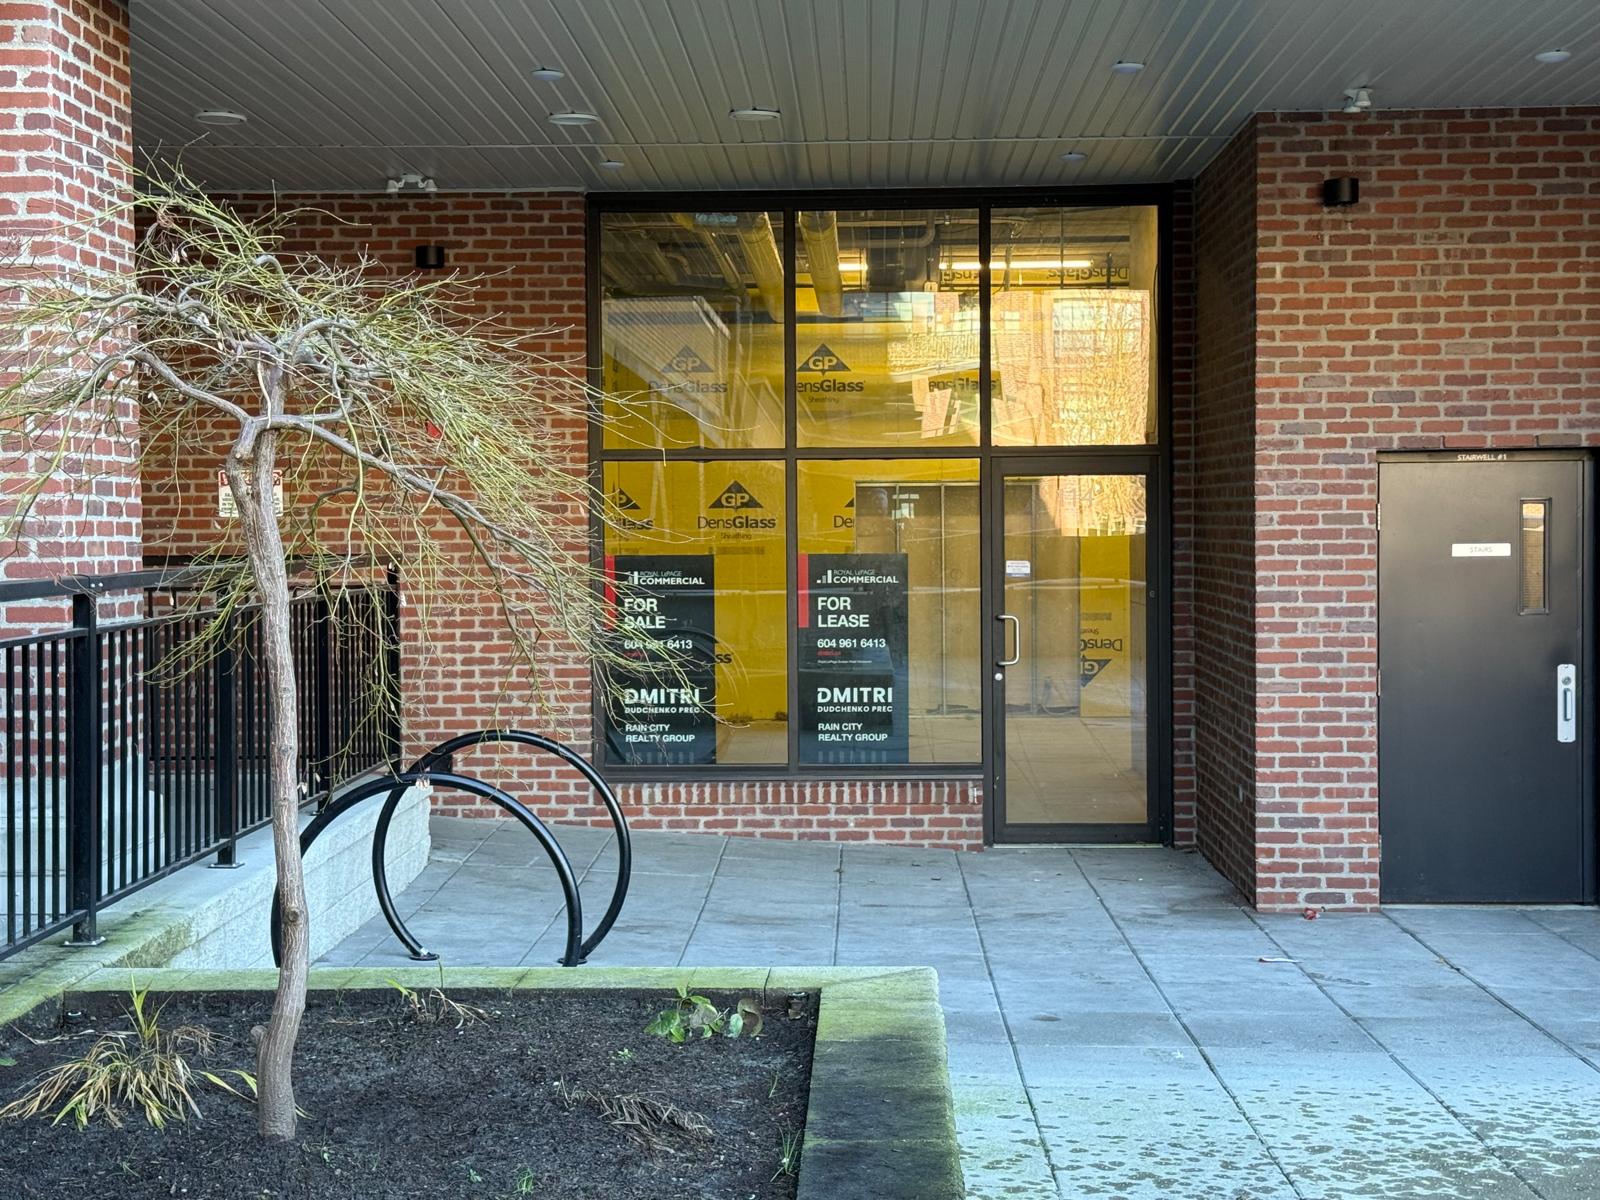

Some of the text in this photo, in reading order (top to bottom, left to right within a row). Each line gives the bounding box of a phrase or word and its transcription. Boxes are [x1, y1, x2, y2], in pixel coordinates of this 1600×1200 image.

[808, 356, 837, 370] GP
[795, 379, 864, 393] ensGlass
[720, 493, 750, 506] GP
[697, 515, 776, 529] DensGlass
[1469, 546, 1493, 554] STAIRS
[639, 577, 705, 585] COMMERCIAL
[833, 576, 899, 584] COMMERCIAL
[624, 598, 658, 612] FOR
[817, 596, 851, 610] FOR
[624, 615, 666, 629] SALE
[817, 614, 870, 628] LEASE
[667, 640, 692, 649] 6413
[817, 638, 886, 648] 604 961 6413
[624, 688, 700, 704] DMITRI
[817, 687, 893, 703] DMITRI
[625, 724, 670, 732] RAIN CITY
[818, 723, 863, 731] RAIN CITY
[625, 734, 695, 742] REALTY GROUP
